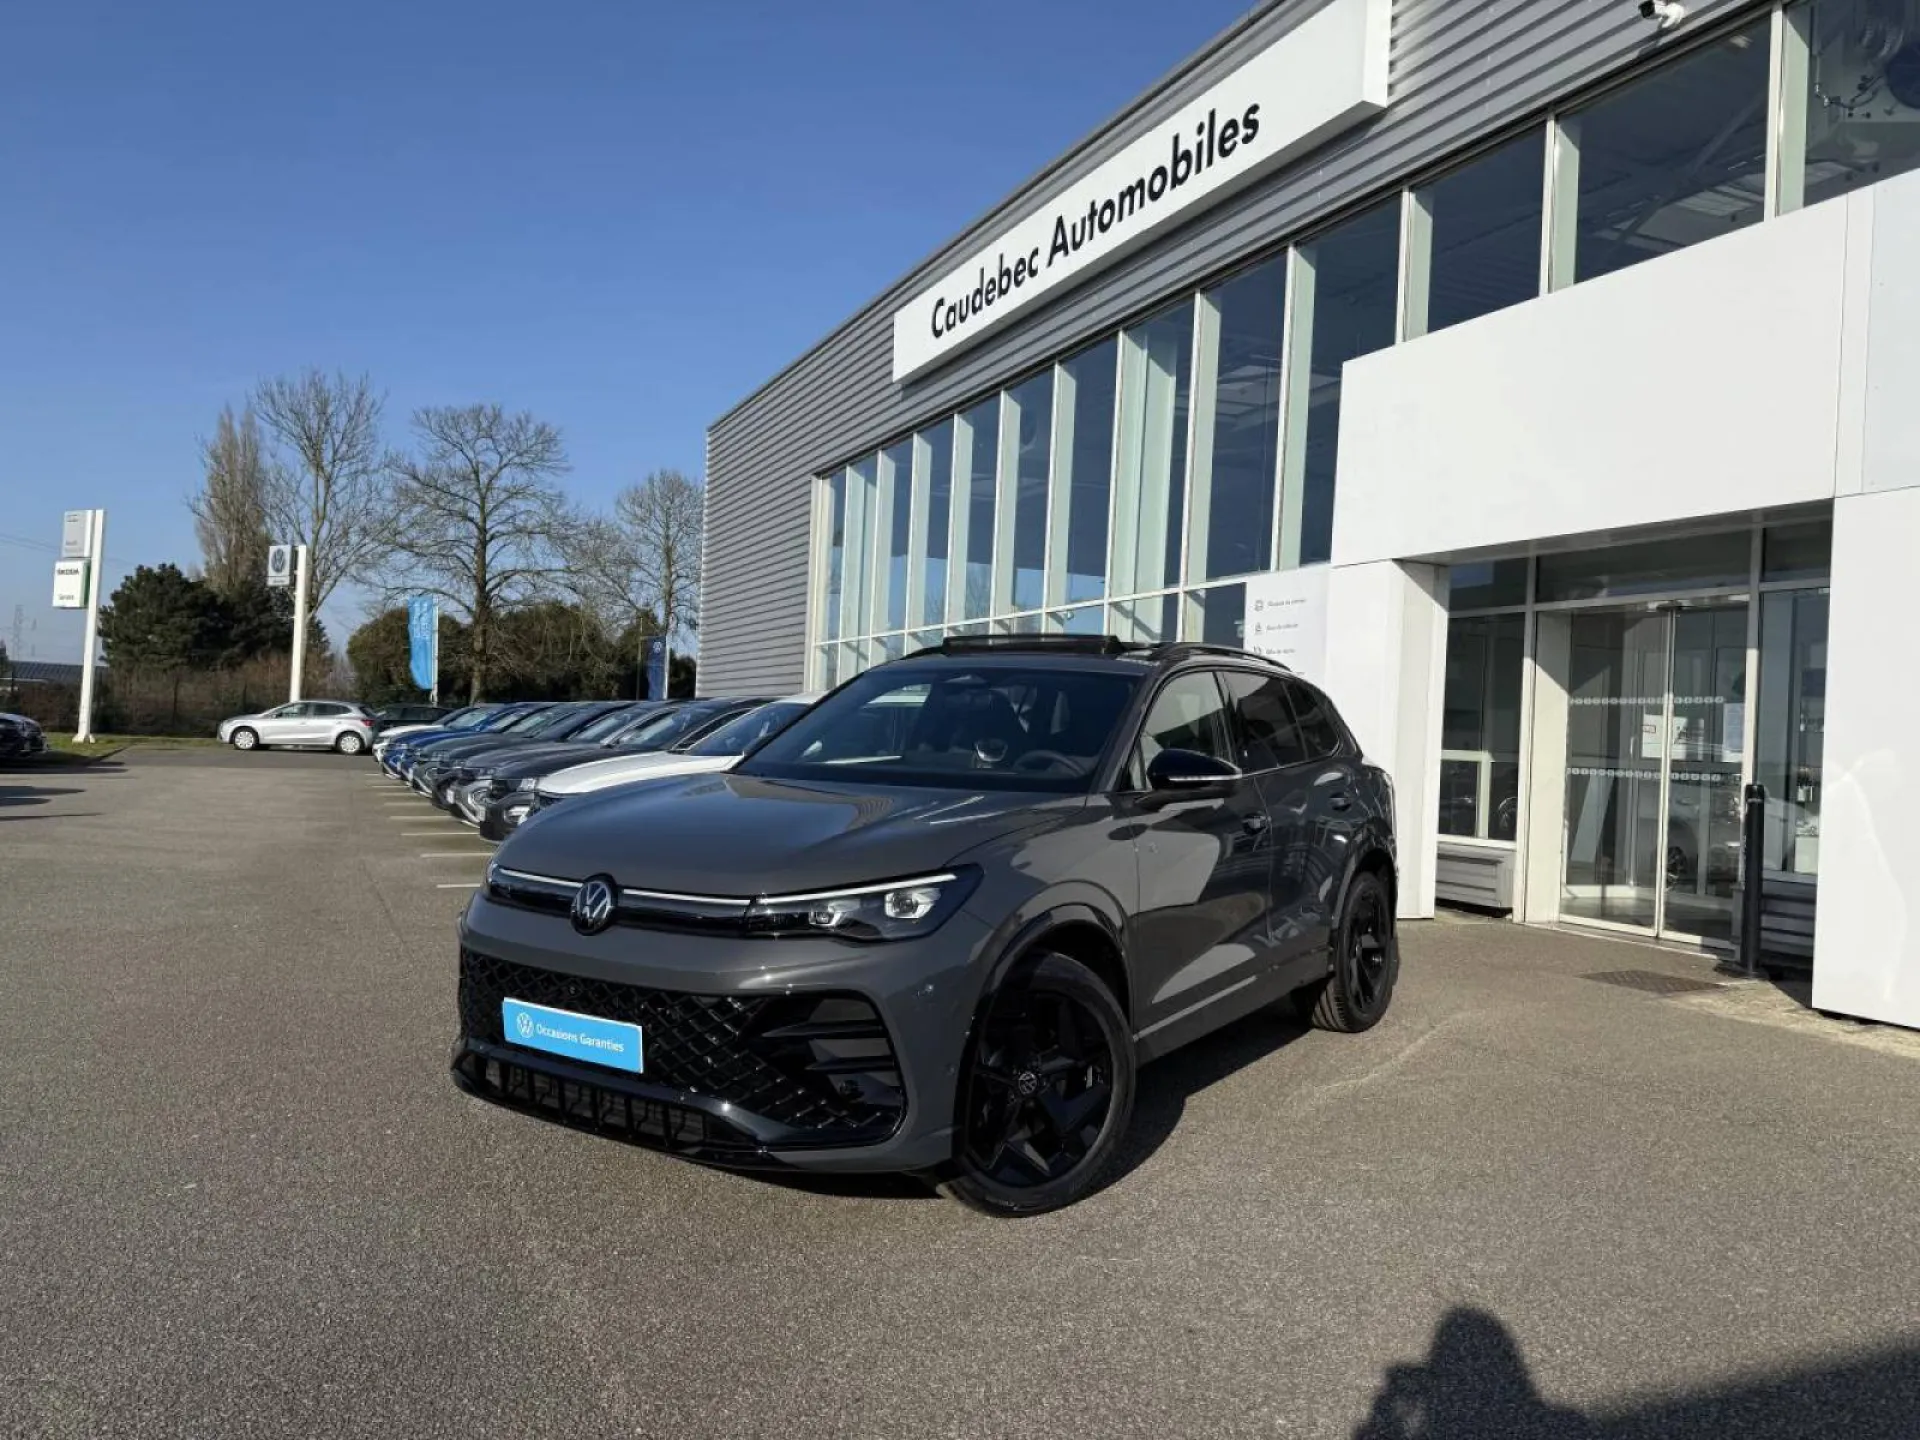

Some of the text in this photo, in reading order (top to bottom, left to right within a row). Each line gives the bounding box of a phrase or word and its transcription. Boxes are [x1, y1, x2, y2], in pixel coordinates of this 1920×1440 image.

[931, 102, 1260, 339] Caudebec Automobiles
[535, 1022, 625, 1053] Occasions Garanties
